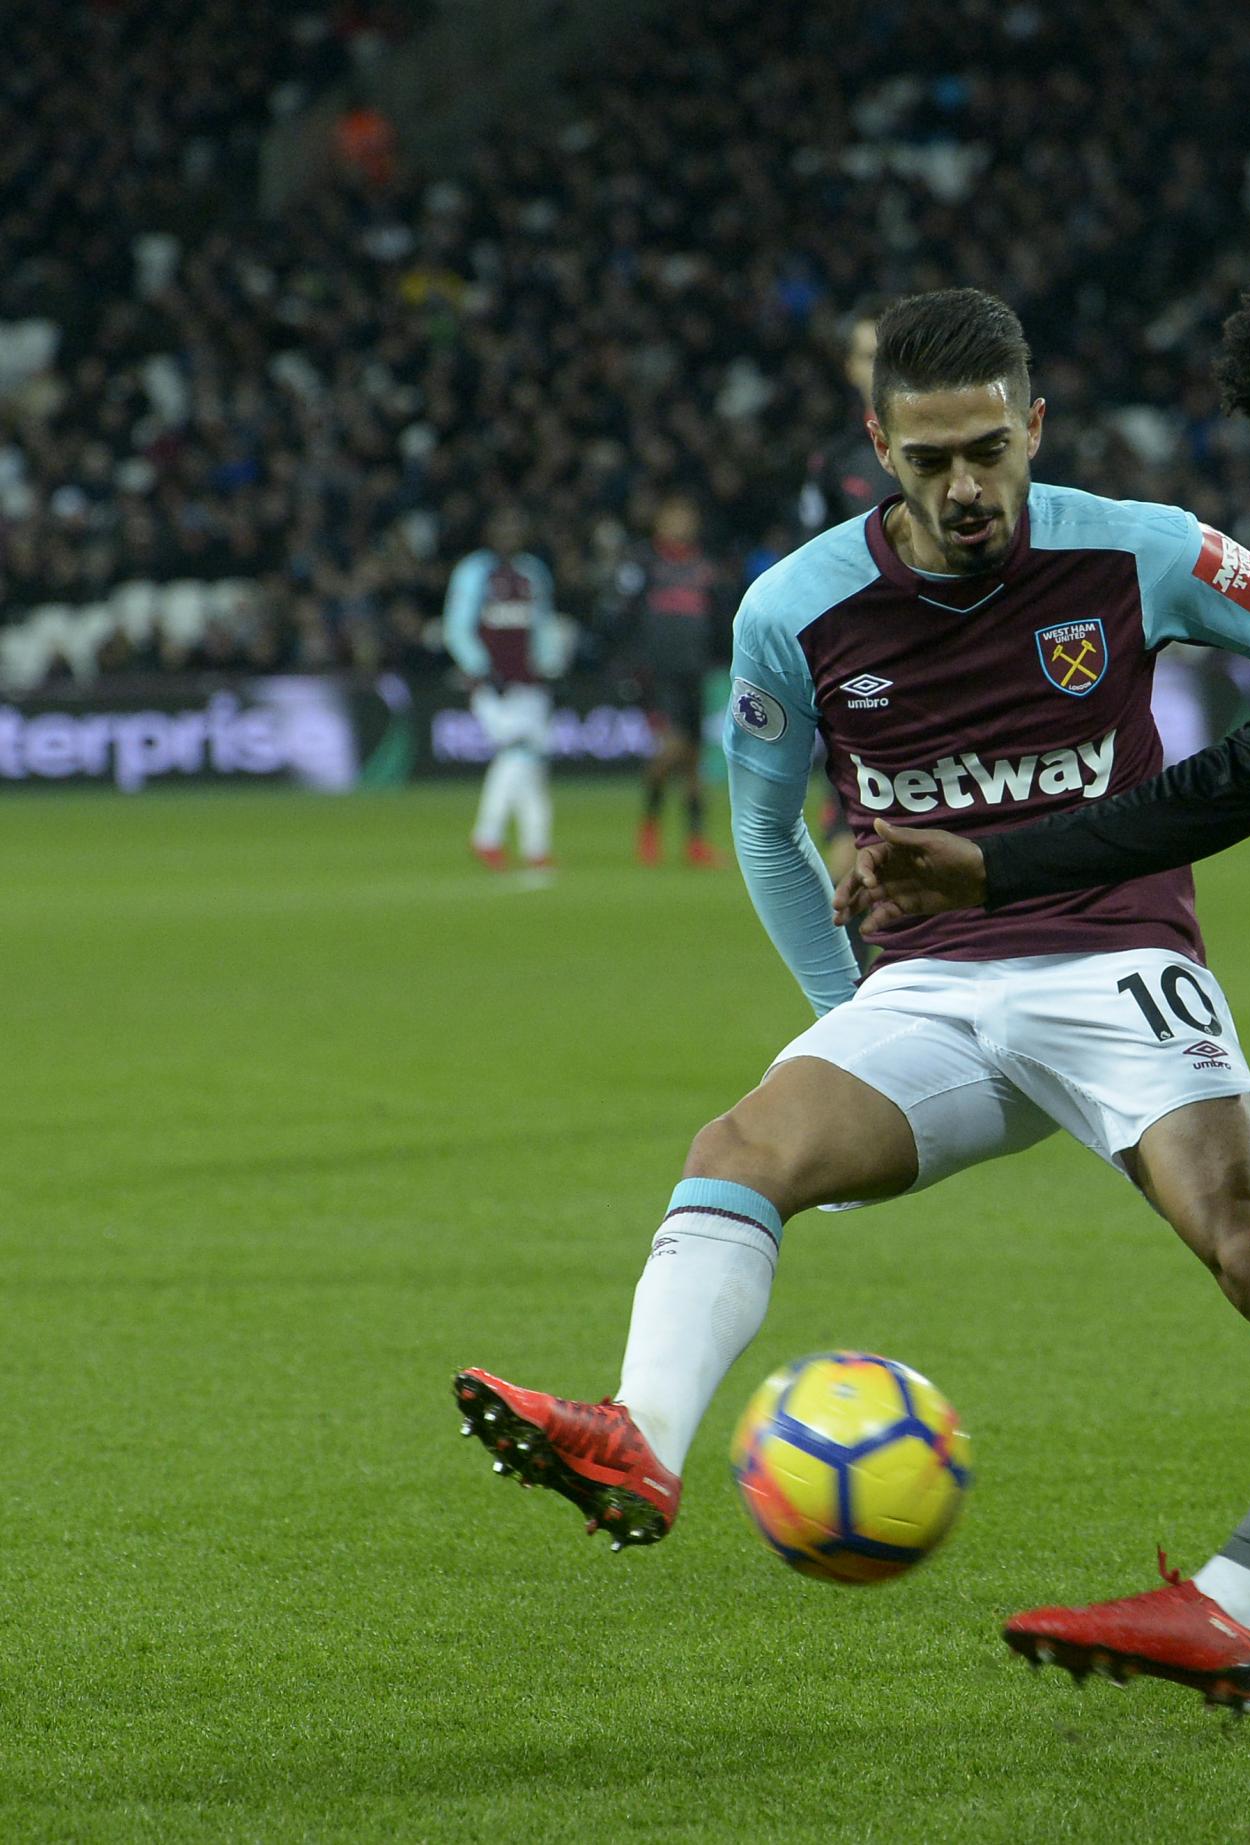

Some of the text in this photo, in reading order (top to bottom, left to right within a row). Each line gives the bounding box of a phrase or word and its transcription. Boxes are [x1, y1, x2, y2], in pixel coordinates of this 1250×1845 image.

[1042, 623, 1096, 640] WEST HAM
[1055, 632, 1086, 644] UNITED
[847, 697, 889, 709] umbro
[850, 729, 1118, 813] betway
[1117, 965, 1223, 1042] 10
[1193, 1059, 1232, 1071] umbro
